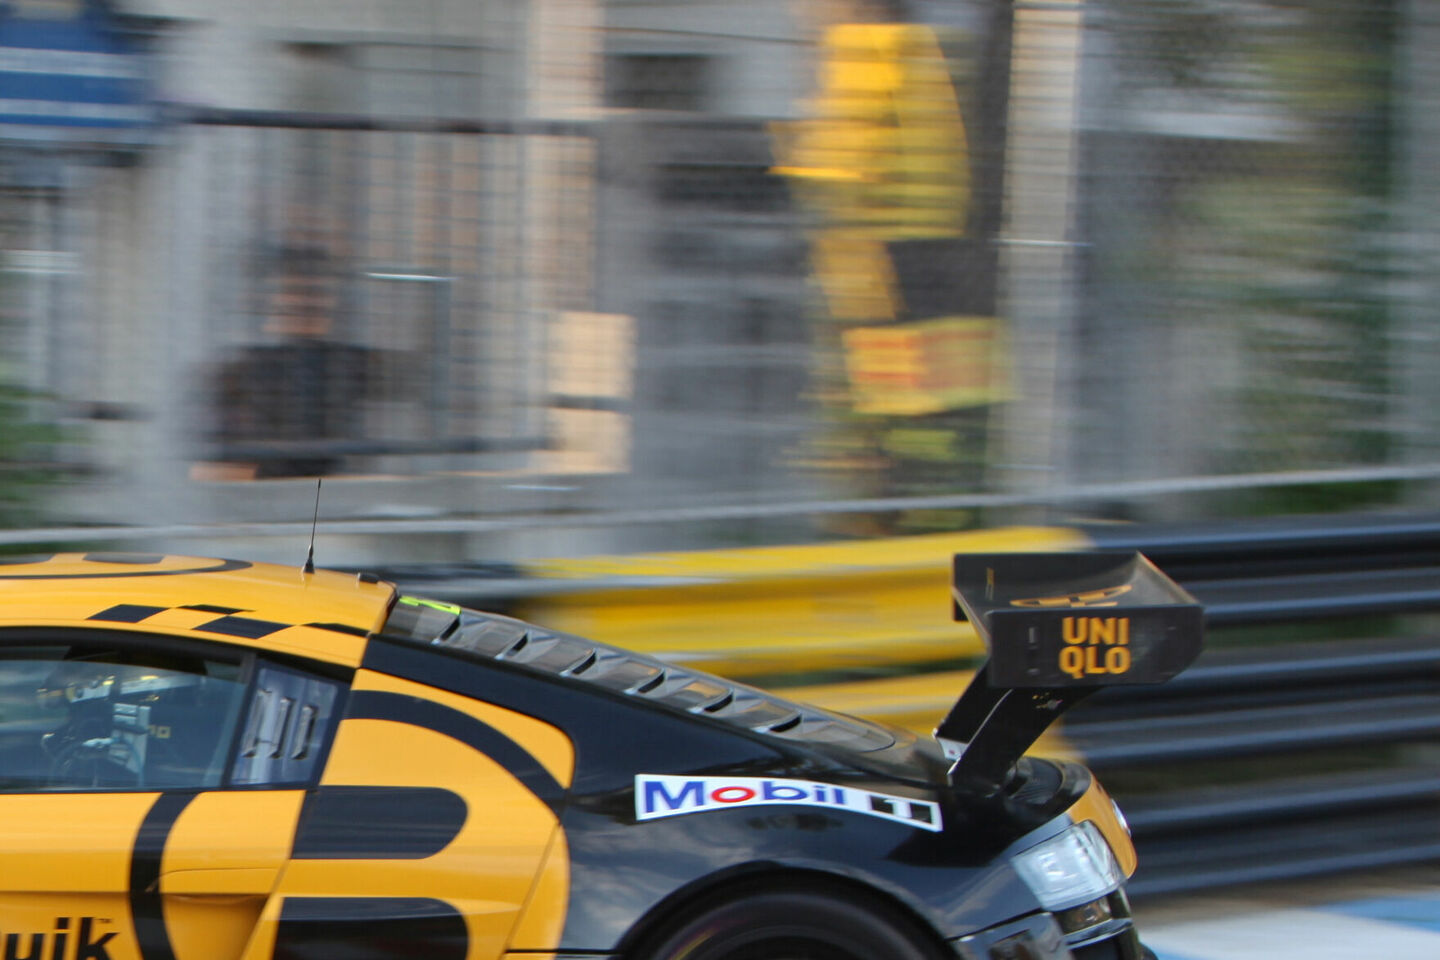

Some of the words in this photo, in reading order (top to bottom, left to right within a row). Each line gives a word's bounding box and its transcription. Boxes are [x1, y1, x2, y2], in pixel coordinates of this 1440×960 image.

[1062, 616, 1130, 645] UNI
[1058, 645, 1132, 679] QLO
[644, 779, 848, 814] Mobil
